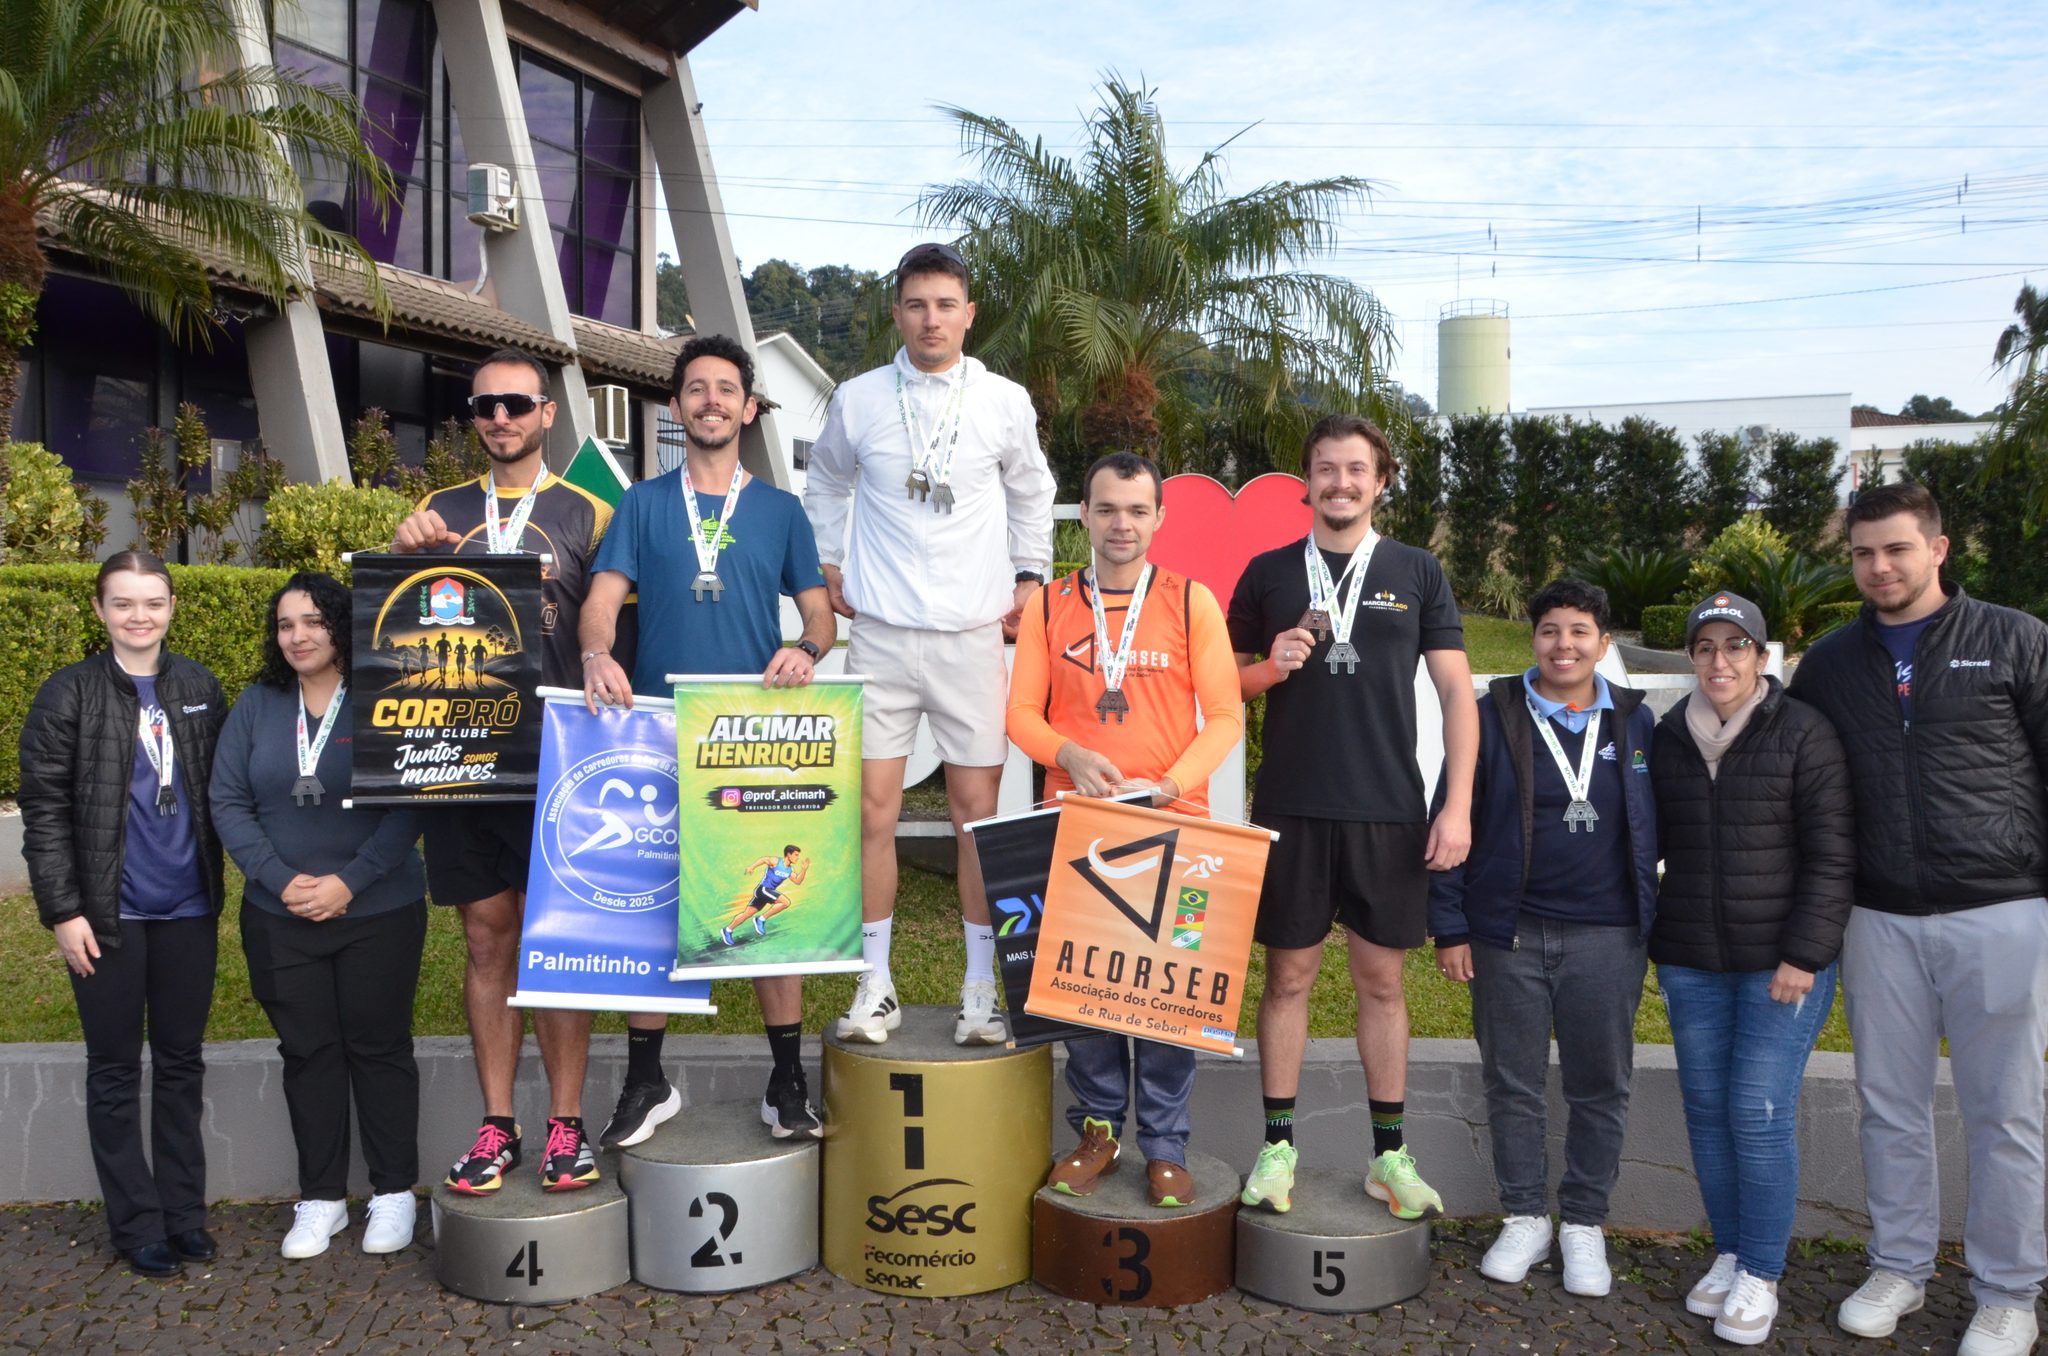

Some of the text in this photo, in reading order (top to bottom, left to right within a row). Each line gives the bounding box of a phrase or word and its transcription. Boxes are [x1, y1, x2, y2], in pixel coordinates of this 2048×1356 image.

[1698, 607, 1744, 619] CRESOL
[372, 691, 521, 727] CORPRÓ
[404, 728, 489, 739] RUN CLUBE
[709, 716, 833, 741] ALCIMAR
[394, 741, 499, 770] Juntos somos
[699, 742, 833, 769] HENRIQUE
[400, 763, 497, 785] maiores.
[547, 779, 575, 823] Associação
[583, 754, 630, 775] Corredores
[742, 789, 826, 803] @prof_alcimarh
[634, 827, 680, 845] GCO
[637, 849, 680, 860] Palmitinh
[592, 891, 655, 908] Desde 2025
[528, 951, 651, 975] Palmitinho
[1006, 951, 1029, 963] MAIS
[1056, 940, 1229, 1006] ACORSEB
[1050, 976, 1223, 1023] Associação dos Corredores
[1078, 1004, 1094, 1017] de
[1099, 1007, 1121, 1022] Rua
[1126, 1013, 1142, 1027] de
[1146, 1017, 1188, 1036] Seberi
[889, 1072, 925, 1170] 1
[865, 1194, 976, 1236] Sesc
[689, 1191, 743, 1268] 2
[505, 1240, 544, 1286] 4
[1101, 1226, 1152, 1301] 3
[1312, 1250, 1347, 1297] 5
[865, 1267, 923, 1289] Senac
